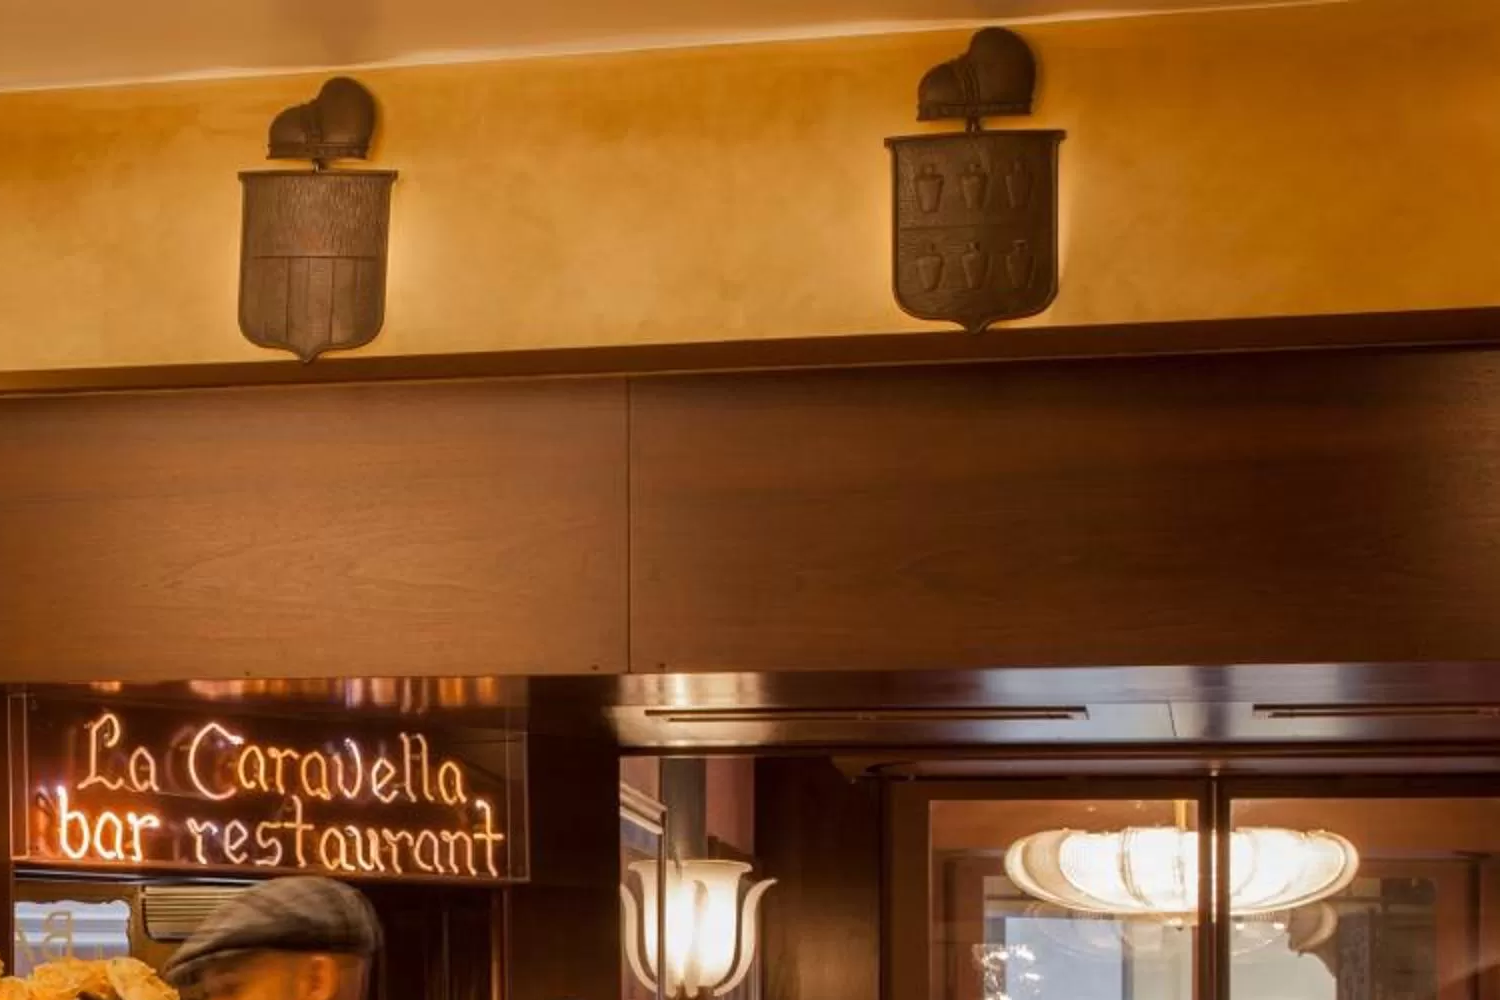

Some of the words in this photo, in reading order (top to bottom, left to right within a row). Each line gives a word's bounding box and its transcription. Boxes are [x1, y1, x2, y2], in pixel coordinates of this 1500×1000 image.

[77, 712, 160, 793] La
[188, 721, 470, 804] Caravella
[56, 785, 161, 862] bar
[187, 795, 505, 878] restaurant
